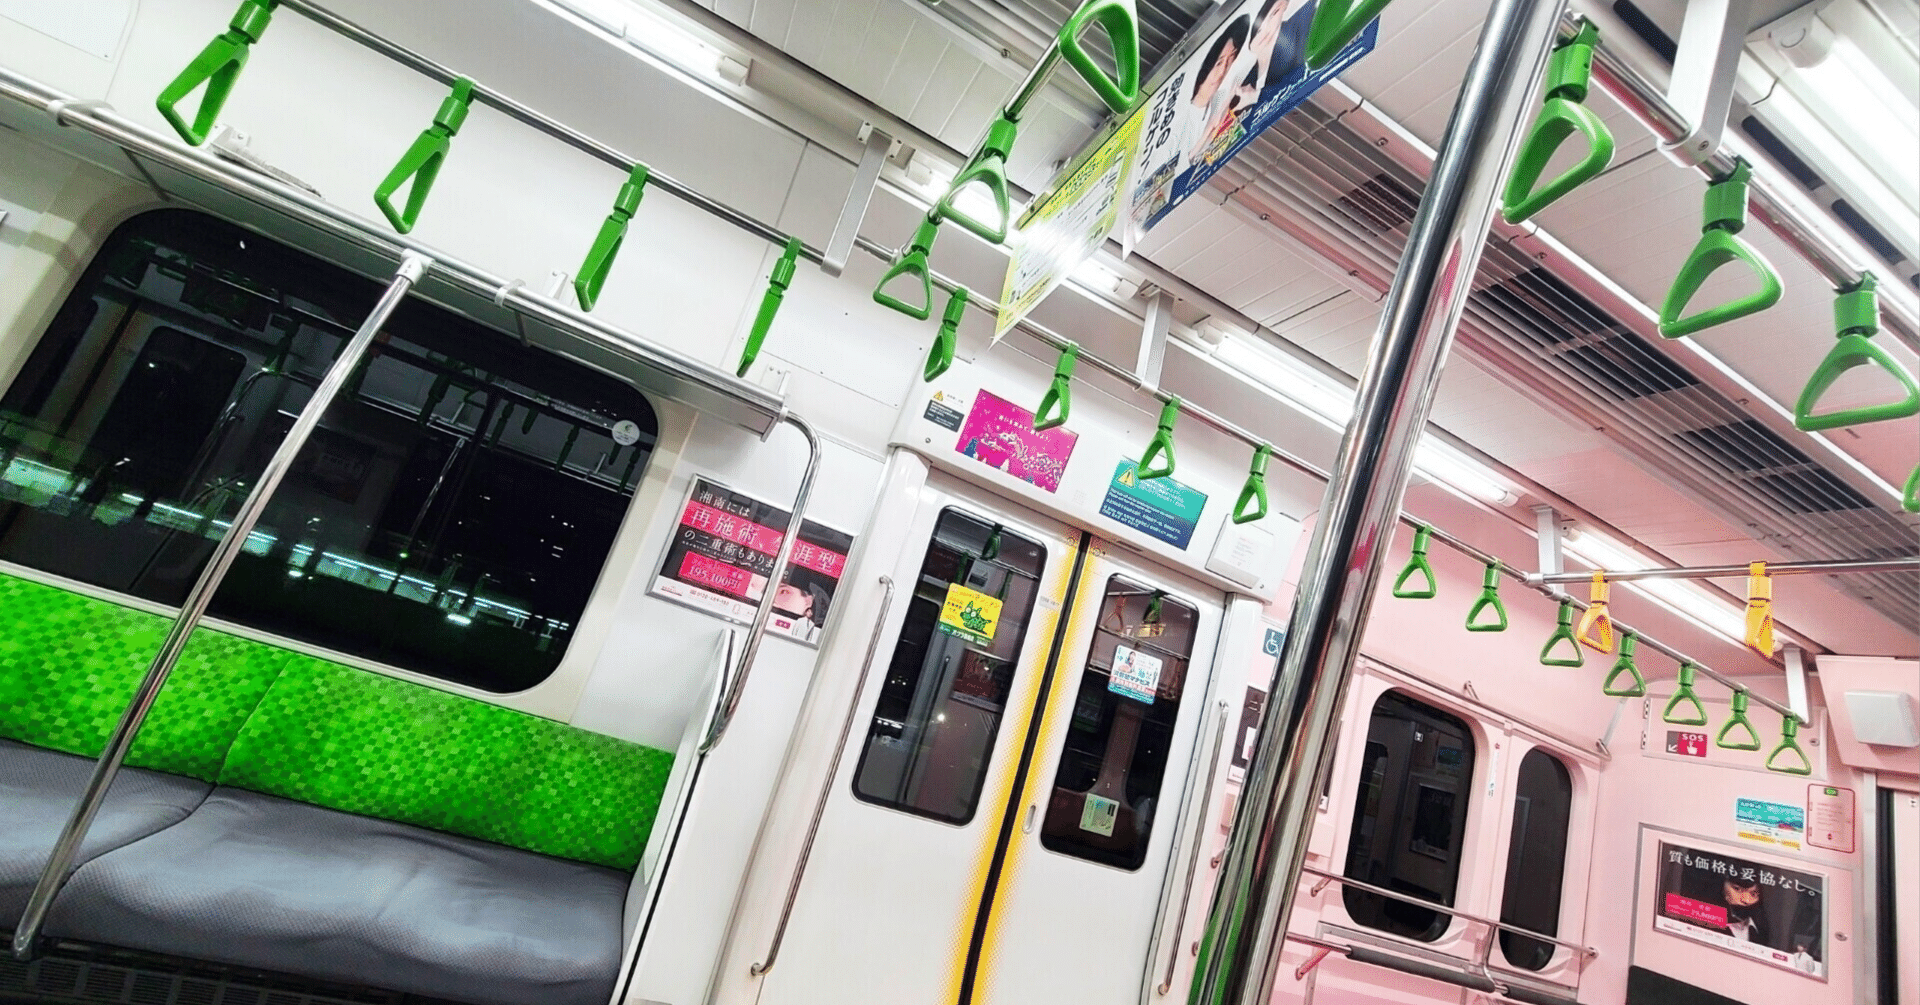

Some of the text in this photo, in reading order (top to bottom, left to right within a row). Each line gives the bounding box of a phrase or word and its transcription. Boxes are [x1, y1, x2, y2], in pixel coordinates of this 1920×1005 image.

[700, 491, 750, 517] 湘南には
[684, 529, 789, 576] の二重術もありま。
[1682, 732, 1704, 742] SOS
[1668, 851, 1816, 896] 質も価格も妥協なし。
